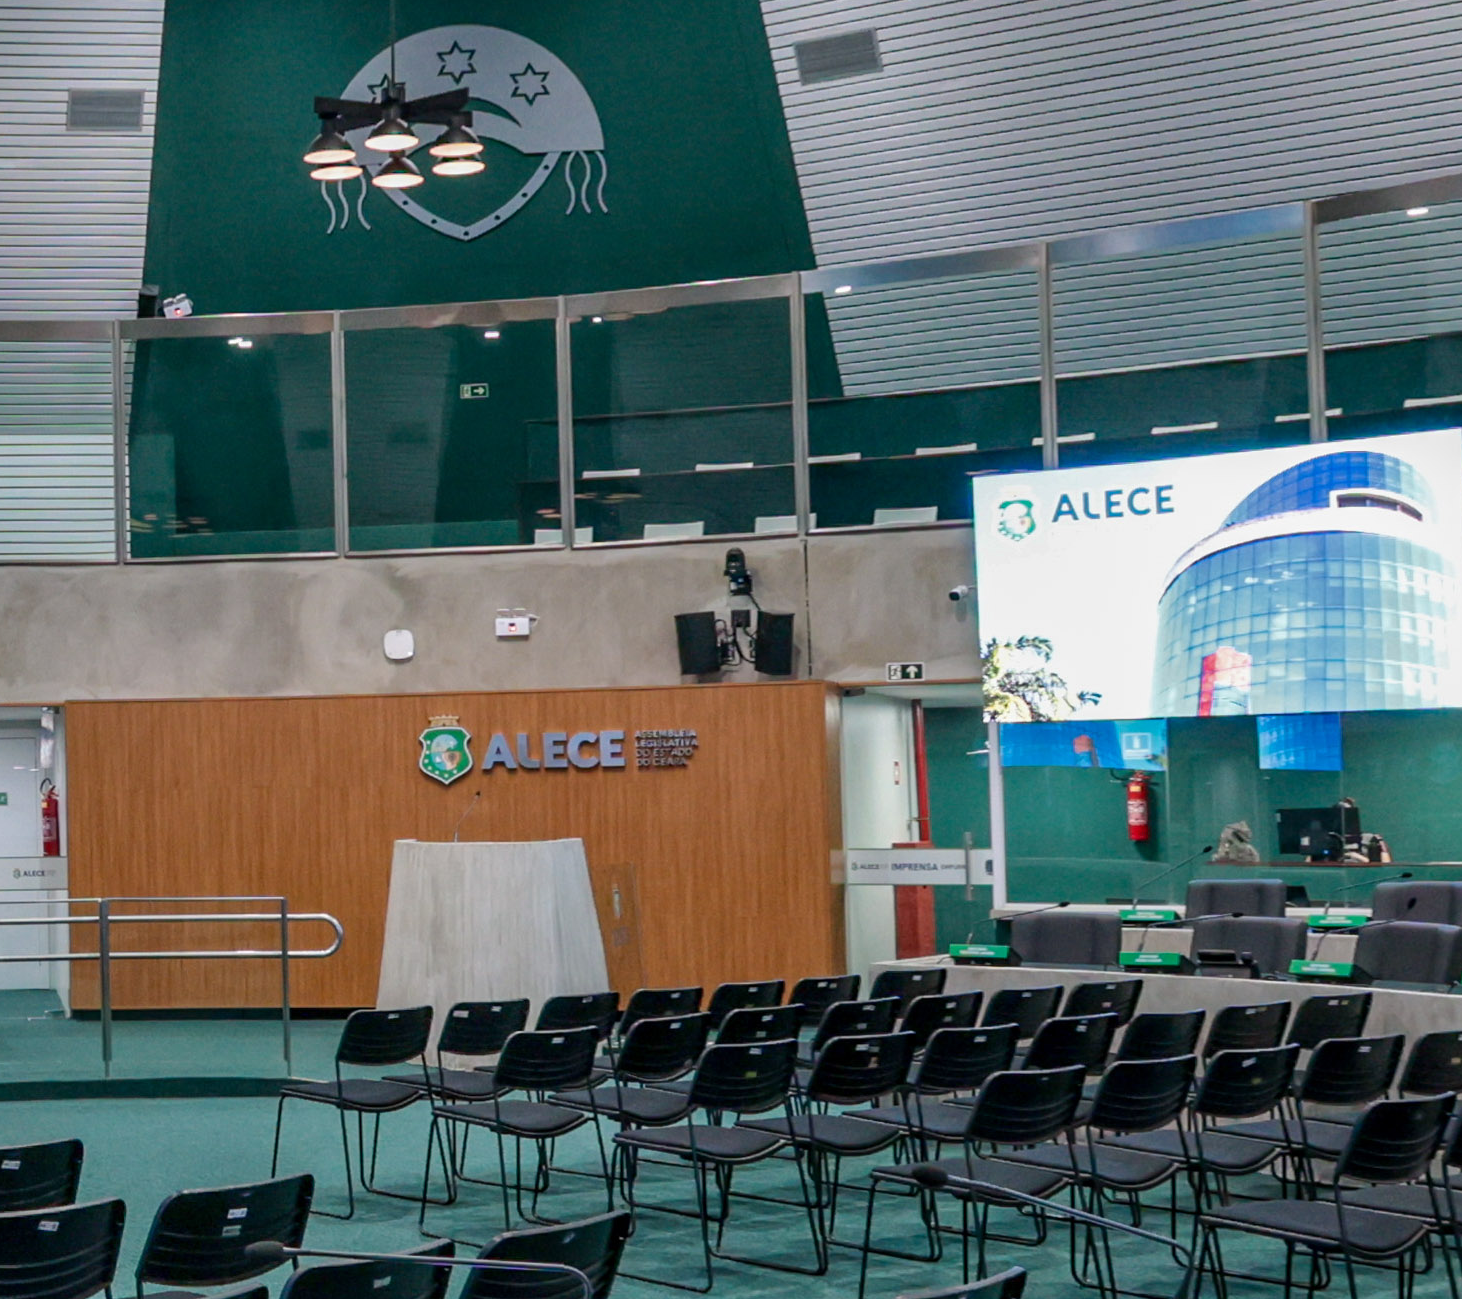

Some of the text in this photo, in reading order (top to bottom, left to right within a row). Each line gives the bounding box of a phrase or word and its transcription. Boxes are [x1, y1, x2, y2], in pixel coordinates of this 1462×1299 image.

[1051, 484, 1175, 523] ALECE
[481, 729, 626, 769] ALECE
[22, 869, 46, 878] ALECE
[891, 862, 938, 872] IMPRENSA
